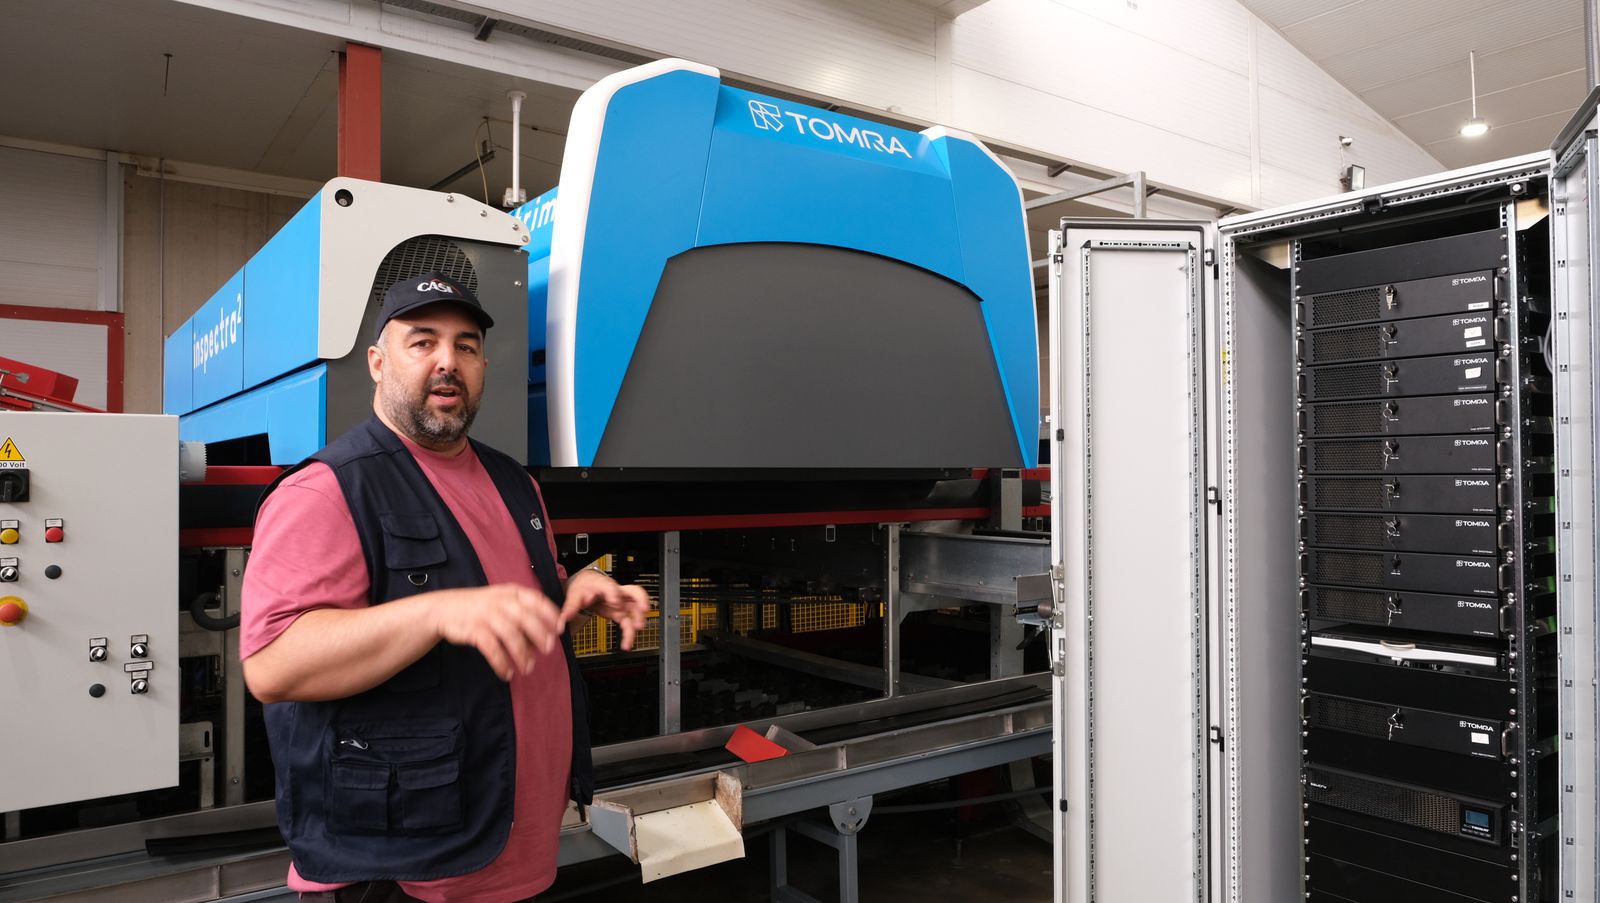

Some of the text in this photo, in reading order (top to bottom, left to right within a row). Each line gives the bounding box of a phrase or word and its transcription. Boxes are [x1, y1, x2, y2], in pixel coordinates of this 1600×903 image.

[785, 111, 912, 158] TOMRA
[1460, 276, 1487, 284] TOMRA
[1460, 317, 1487, 325] TOMRA
[1465, 601, 1492, 609] TOMRA
[1467, 722, 1494, 732] TOMRA
